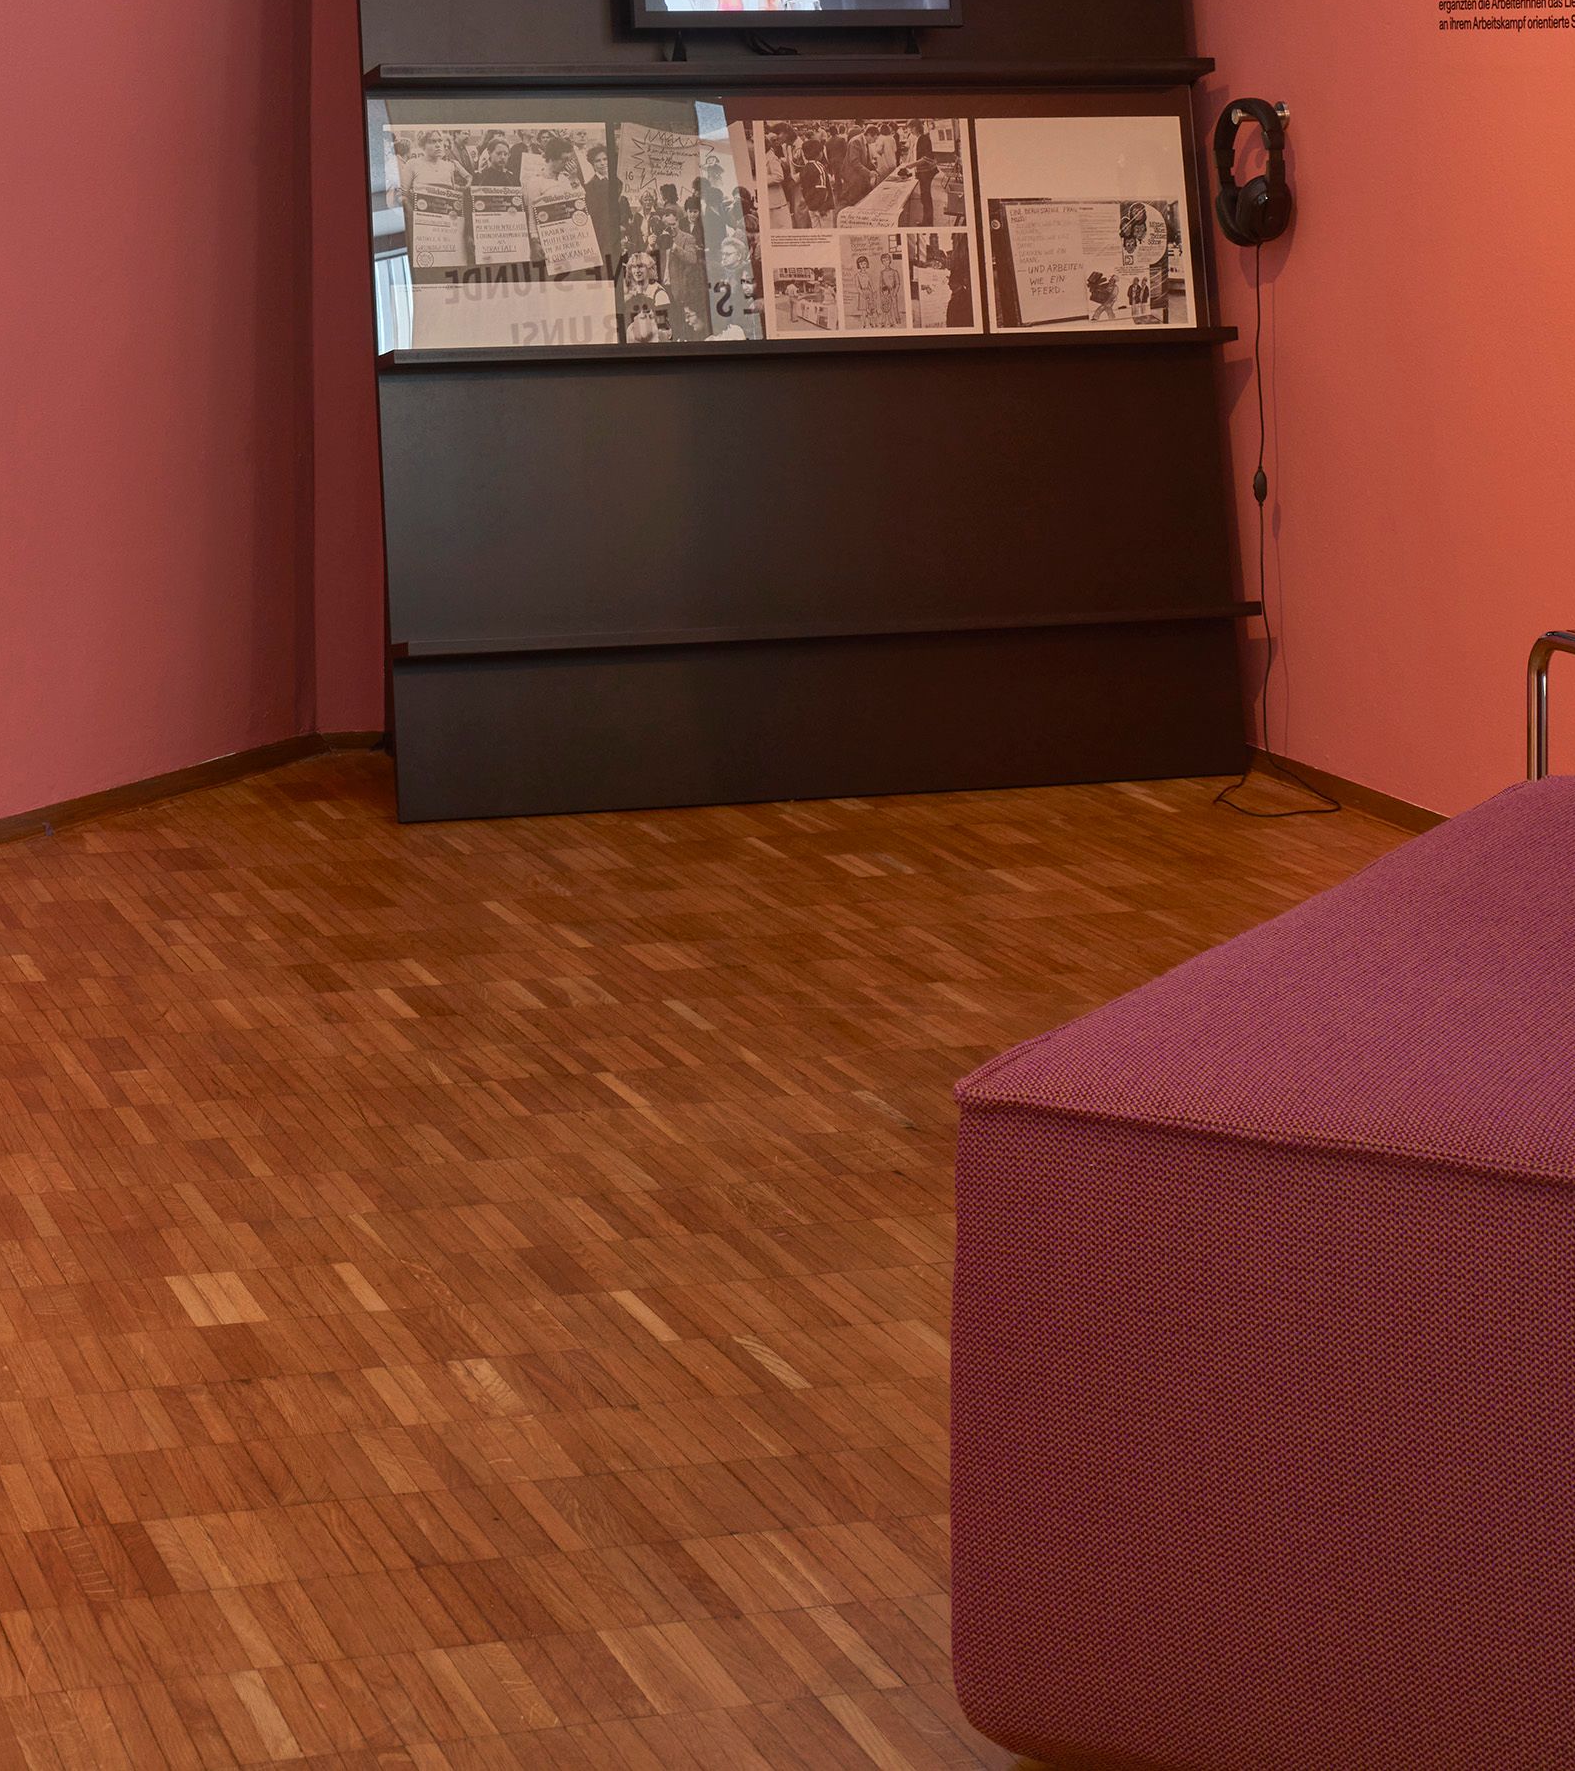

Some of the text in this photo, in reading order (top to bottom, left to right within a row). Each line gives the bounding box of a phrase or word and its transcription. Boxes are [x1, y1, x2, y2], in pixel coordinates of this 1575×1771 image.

[1028, 264, 1045, 274] UND
[1029, 275, 1066, 286] WIE EIN
